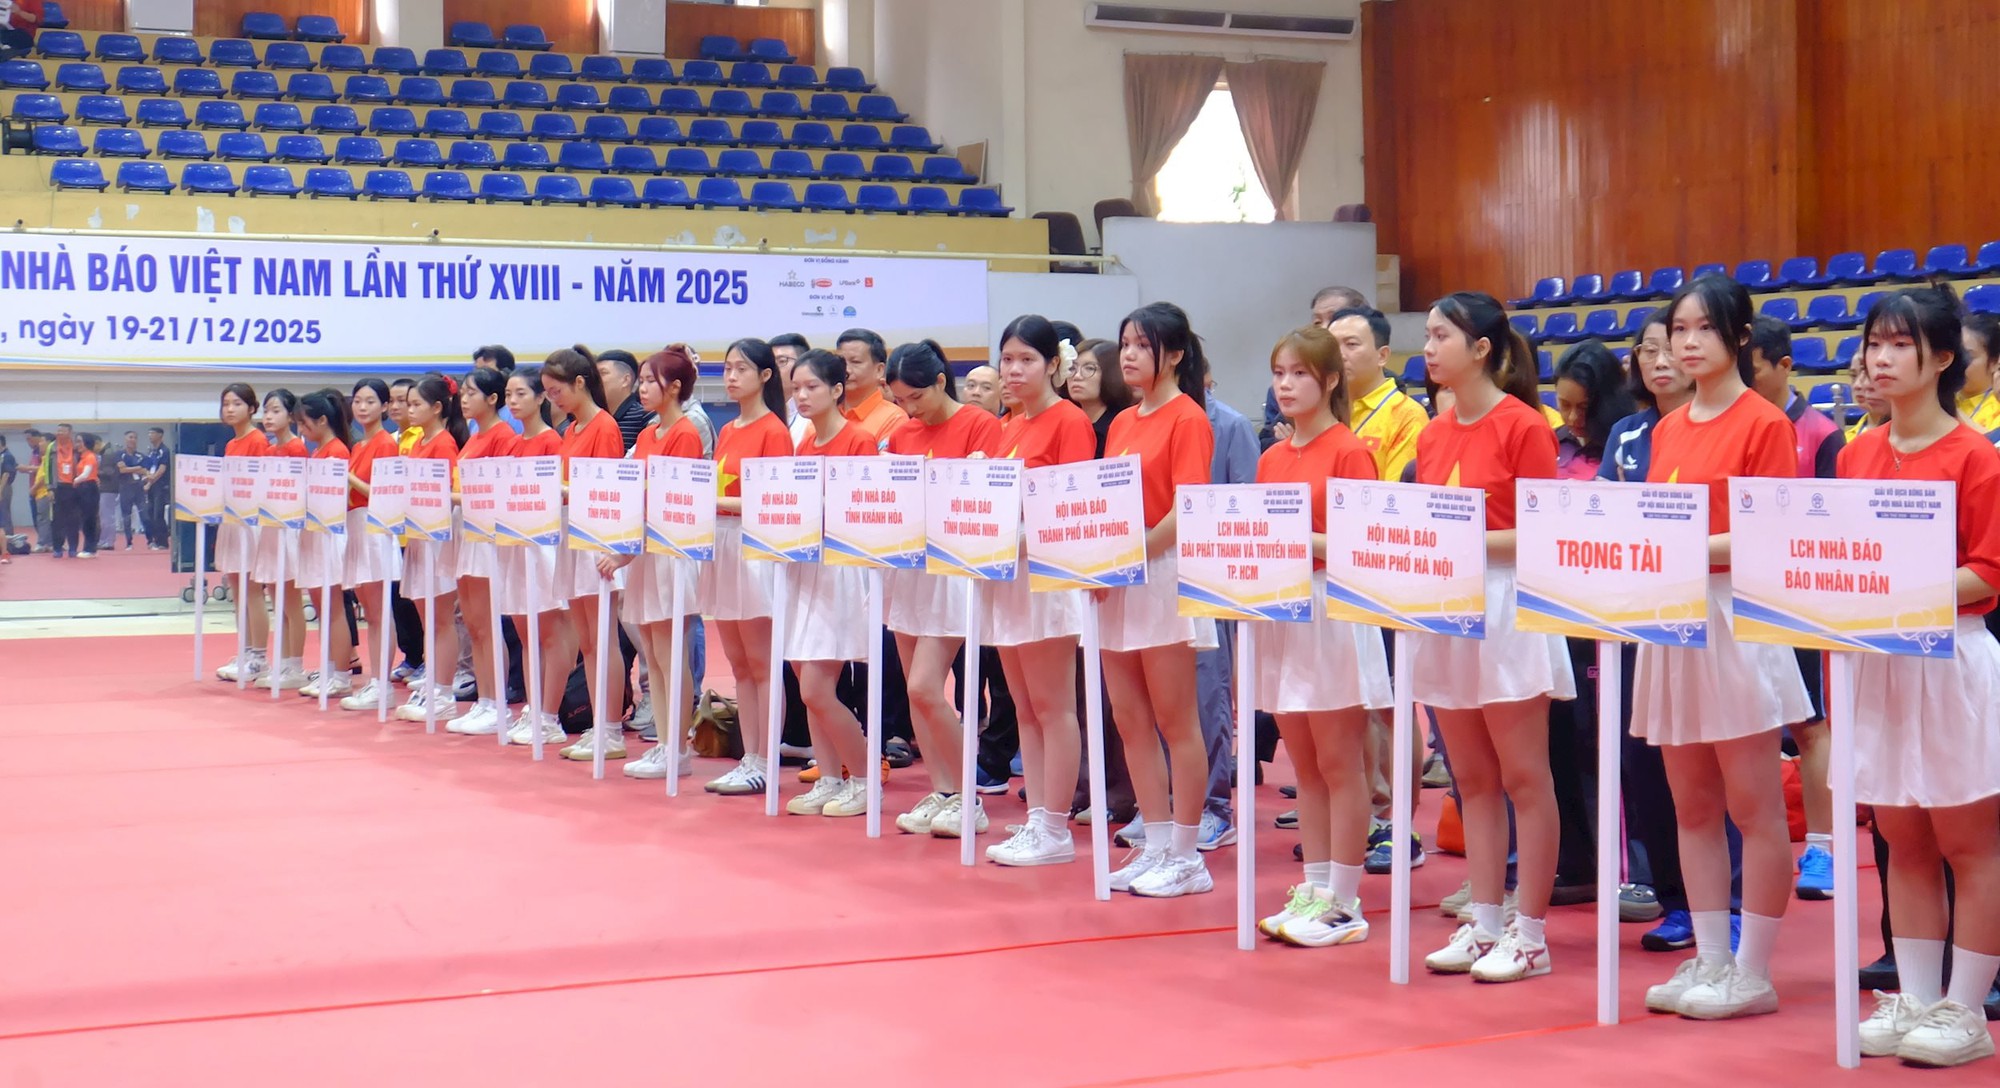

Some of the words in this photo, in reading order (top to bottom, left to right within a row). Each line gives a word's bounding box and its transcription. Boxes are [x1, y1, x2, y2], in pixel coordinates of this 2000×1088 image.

[2, 243, 75, 291] NHÀ
[88, 245, 157, 293] BÁO
[169, 248, 242, 303] VIỆT
[254, 257, 331, 297] NAM
[344, 247, 407, 298] LẦN
[418, 254, 481, 300] THỨ
[489, 263, 560, 300] XVIII
[594, 258, 665, 303] NĂM
[676, 268, 748, 305] 2025
[19, 313, 95, 346] ngày
[107, 316, 321, 344] 19-21/12/2025
[762, 491, 771, 508] HỘI
[772, 491, 784, 505] NHÀ
[785, 492, 797, 505] BÁO
[852, 488, 863, 505] HỘI
[864, 488, 879, 503] NHÀ
[881, 488, 896, 503] BÁO
[951, 497, 961, 516] HỘI
[963, 497, 977, 513] NHÀ
[978, 498, 992, 514] BÁO
[1055, 501, 1069, 521] HỘI
[1071, 499, 1087, 516] NHÀ
[1090, 496, 1106, 514] BÁO
[845, 507, 860, 523] TỈNH
[862, 509, 886, 524] KHÁNH
[943, 517, 958, 535] TỈNH
[959, 518, 980, 536] QUẢNG
[982, 523, 998, 537] NINH
[1218, 521, 1231, 536] LCH
[1234, 519, 1250, 536] NHÀ
[1253, 519, 1268, 536] BÁO
[1038, 526, 1063, 544] THÀNH
[1066, 522, 1081, 541] PHỐ
[1083, 522, 1097, 539] HẢI
[1100, 519, 1129, 538] PHÒNG
[1367, 523, 1384, 545] HỘI
[1388, 526, 1410, 545] NHÀ
[1414, 527, 1436, 548] BÁO
[1182, 540, 1194, 557] ĐÀI
[1196, 540, 1214, 558] PHÁT
[1217, 543, 1241, 558] THANH
[1244, 540, 1254, 558] VÀ
[1256, 539, 1285, 559] TRUYỀN
[1288, 541, 1306, 559] HÌNH
[1557, 539, 1622, 574] TRỌNG
[1629, 539, 1662, 573] TÀI
[1790, 539, 1815, 559] LCH
[1819, 537, 1847, 560] NHÀ
[1852, 538, 1882, 561] BÁO
[1227, 565, 1237, 580] TP.
[1240, 565, 1258, 580] HCM
[1352, 549, 1385, 569] THÀNH
[1389, 551, 1411, 573] PHỐ
[1414, 555, 1429, 575] HÀ
[1433, 557, 1453, 580] NỘI
[1785, 567, 1811, 590] BÁO
[1815, 569, 1854, 592] NHÂN
[1859, 571, 1889, 594] DÂN
